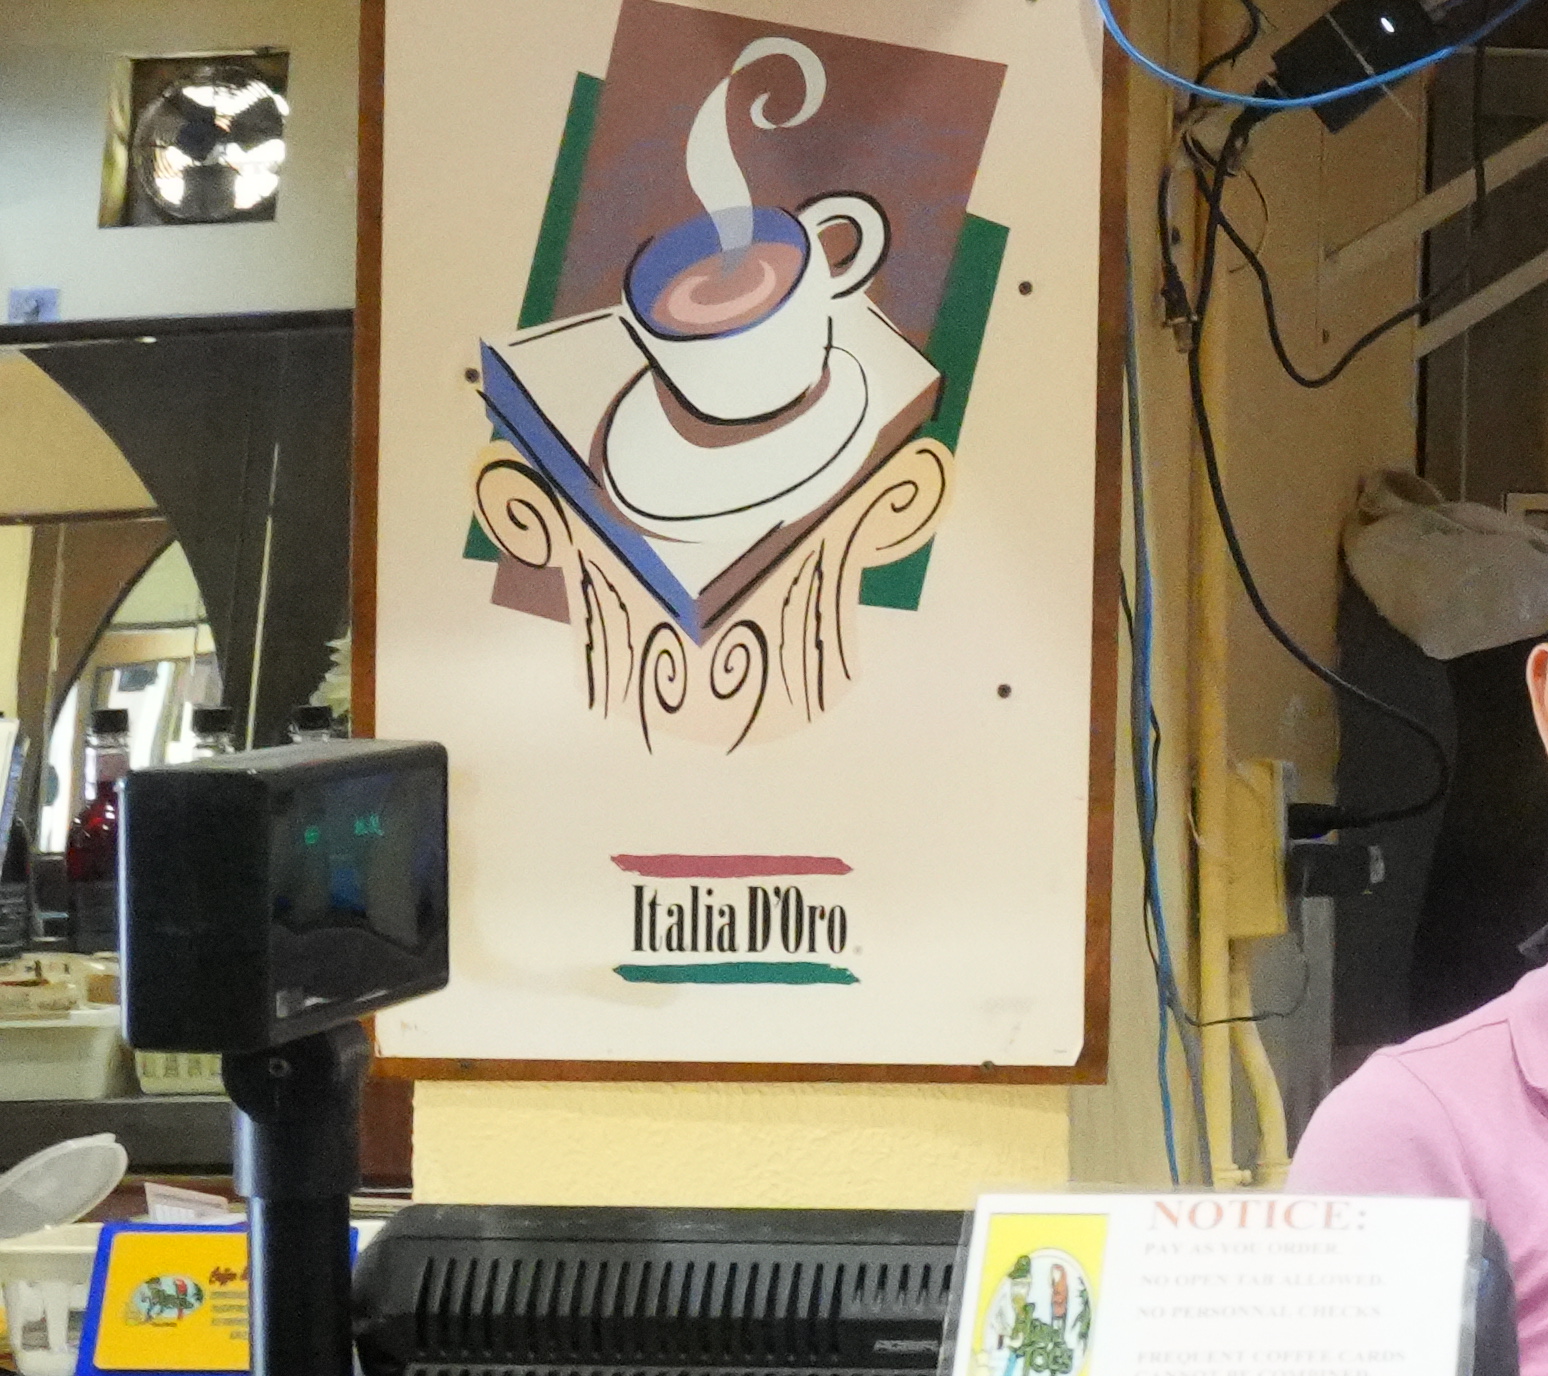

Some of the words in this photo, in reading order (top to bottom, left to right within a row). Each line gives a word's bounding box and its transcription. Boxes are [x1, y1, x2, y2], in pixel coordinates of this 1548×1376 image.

[634, 885, 736, 952] Italia
[748, 886, 846, 952] D'Oro
[1150, 1199, 1369, 1233] NOTICE:
